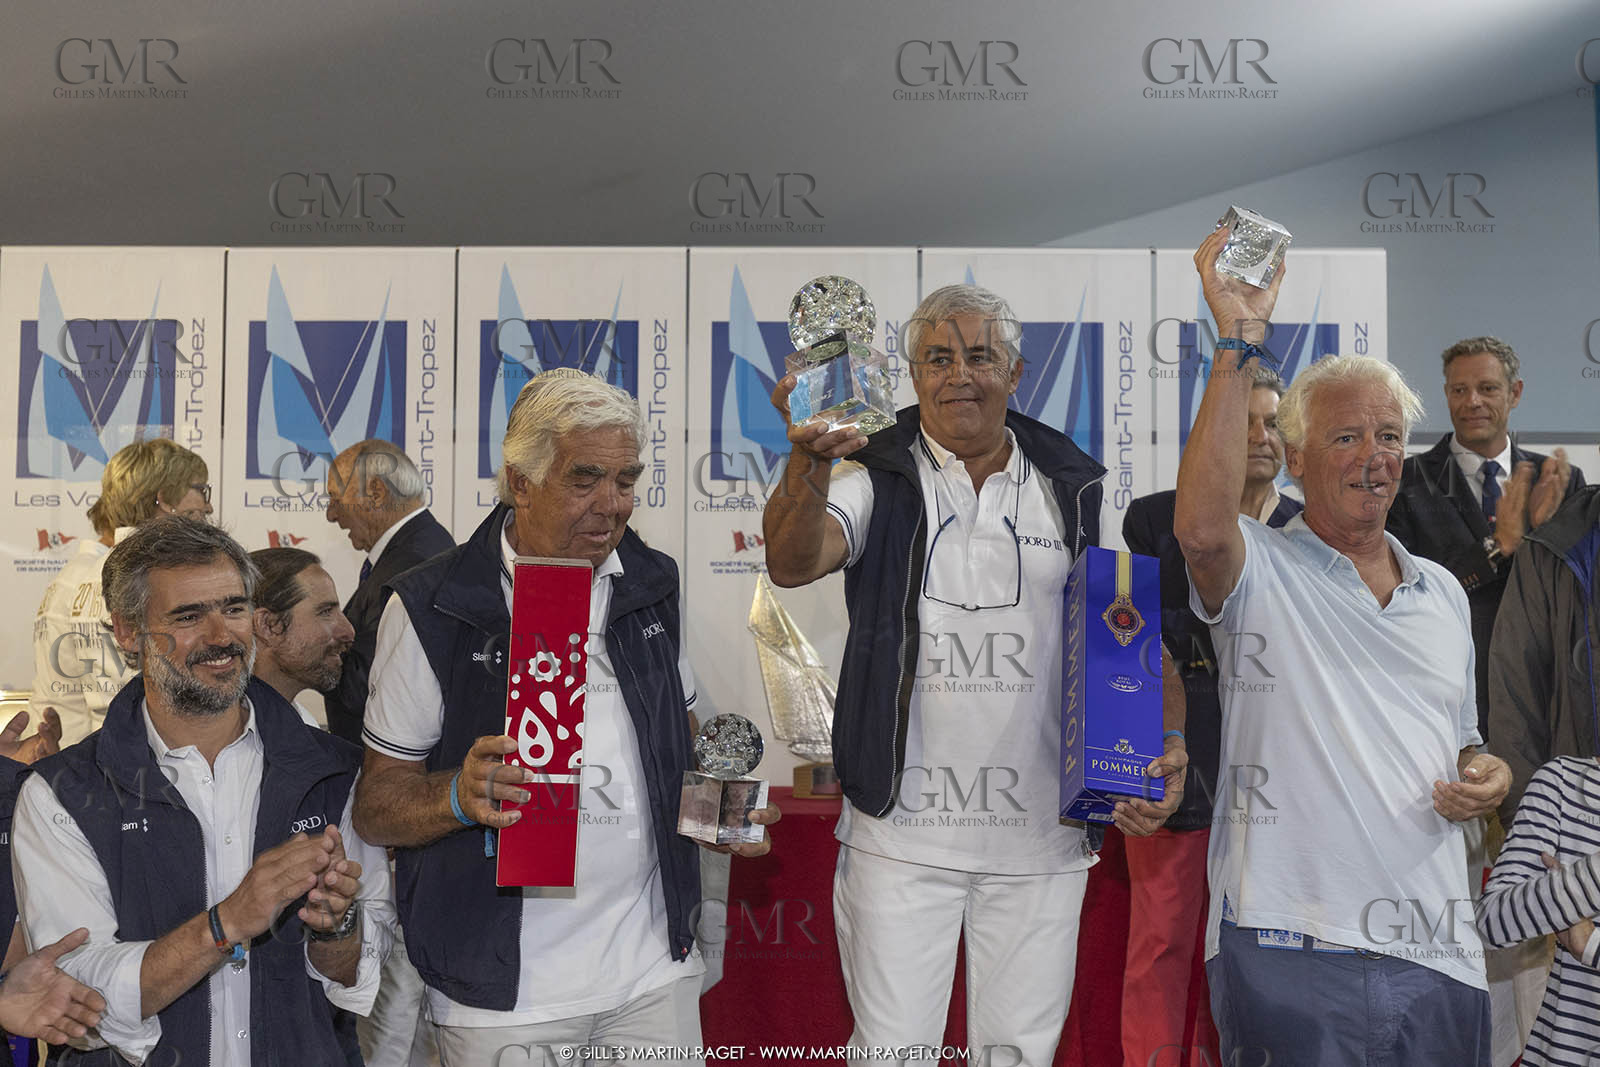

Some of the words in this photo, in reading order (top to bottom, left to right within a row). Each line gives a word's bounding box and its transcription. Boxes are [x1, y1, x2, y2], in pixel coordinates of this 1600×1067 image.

[648, 319, 671, 508] Saint-Tropez
[1114, 320, 1136, 511] Saint-Tropez
[14, 490, 61, 507] Les
[244, 491, 291, 508] Les
[476, 491, 503, 507] Le
[1017, 535, 1052, 549] FJORD
[1065, 577, 1080, 776] POMMERY
[1092, 759, 1147, 777] POMMER
